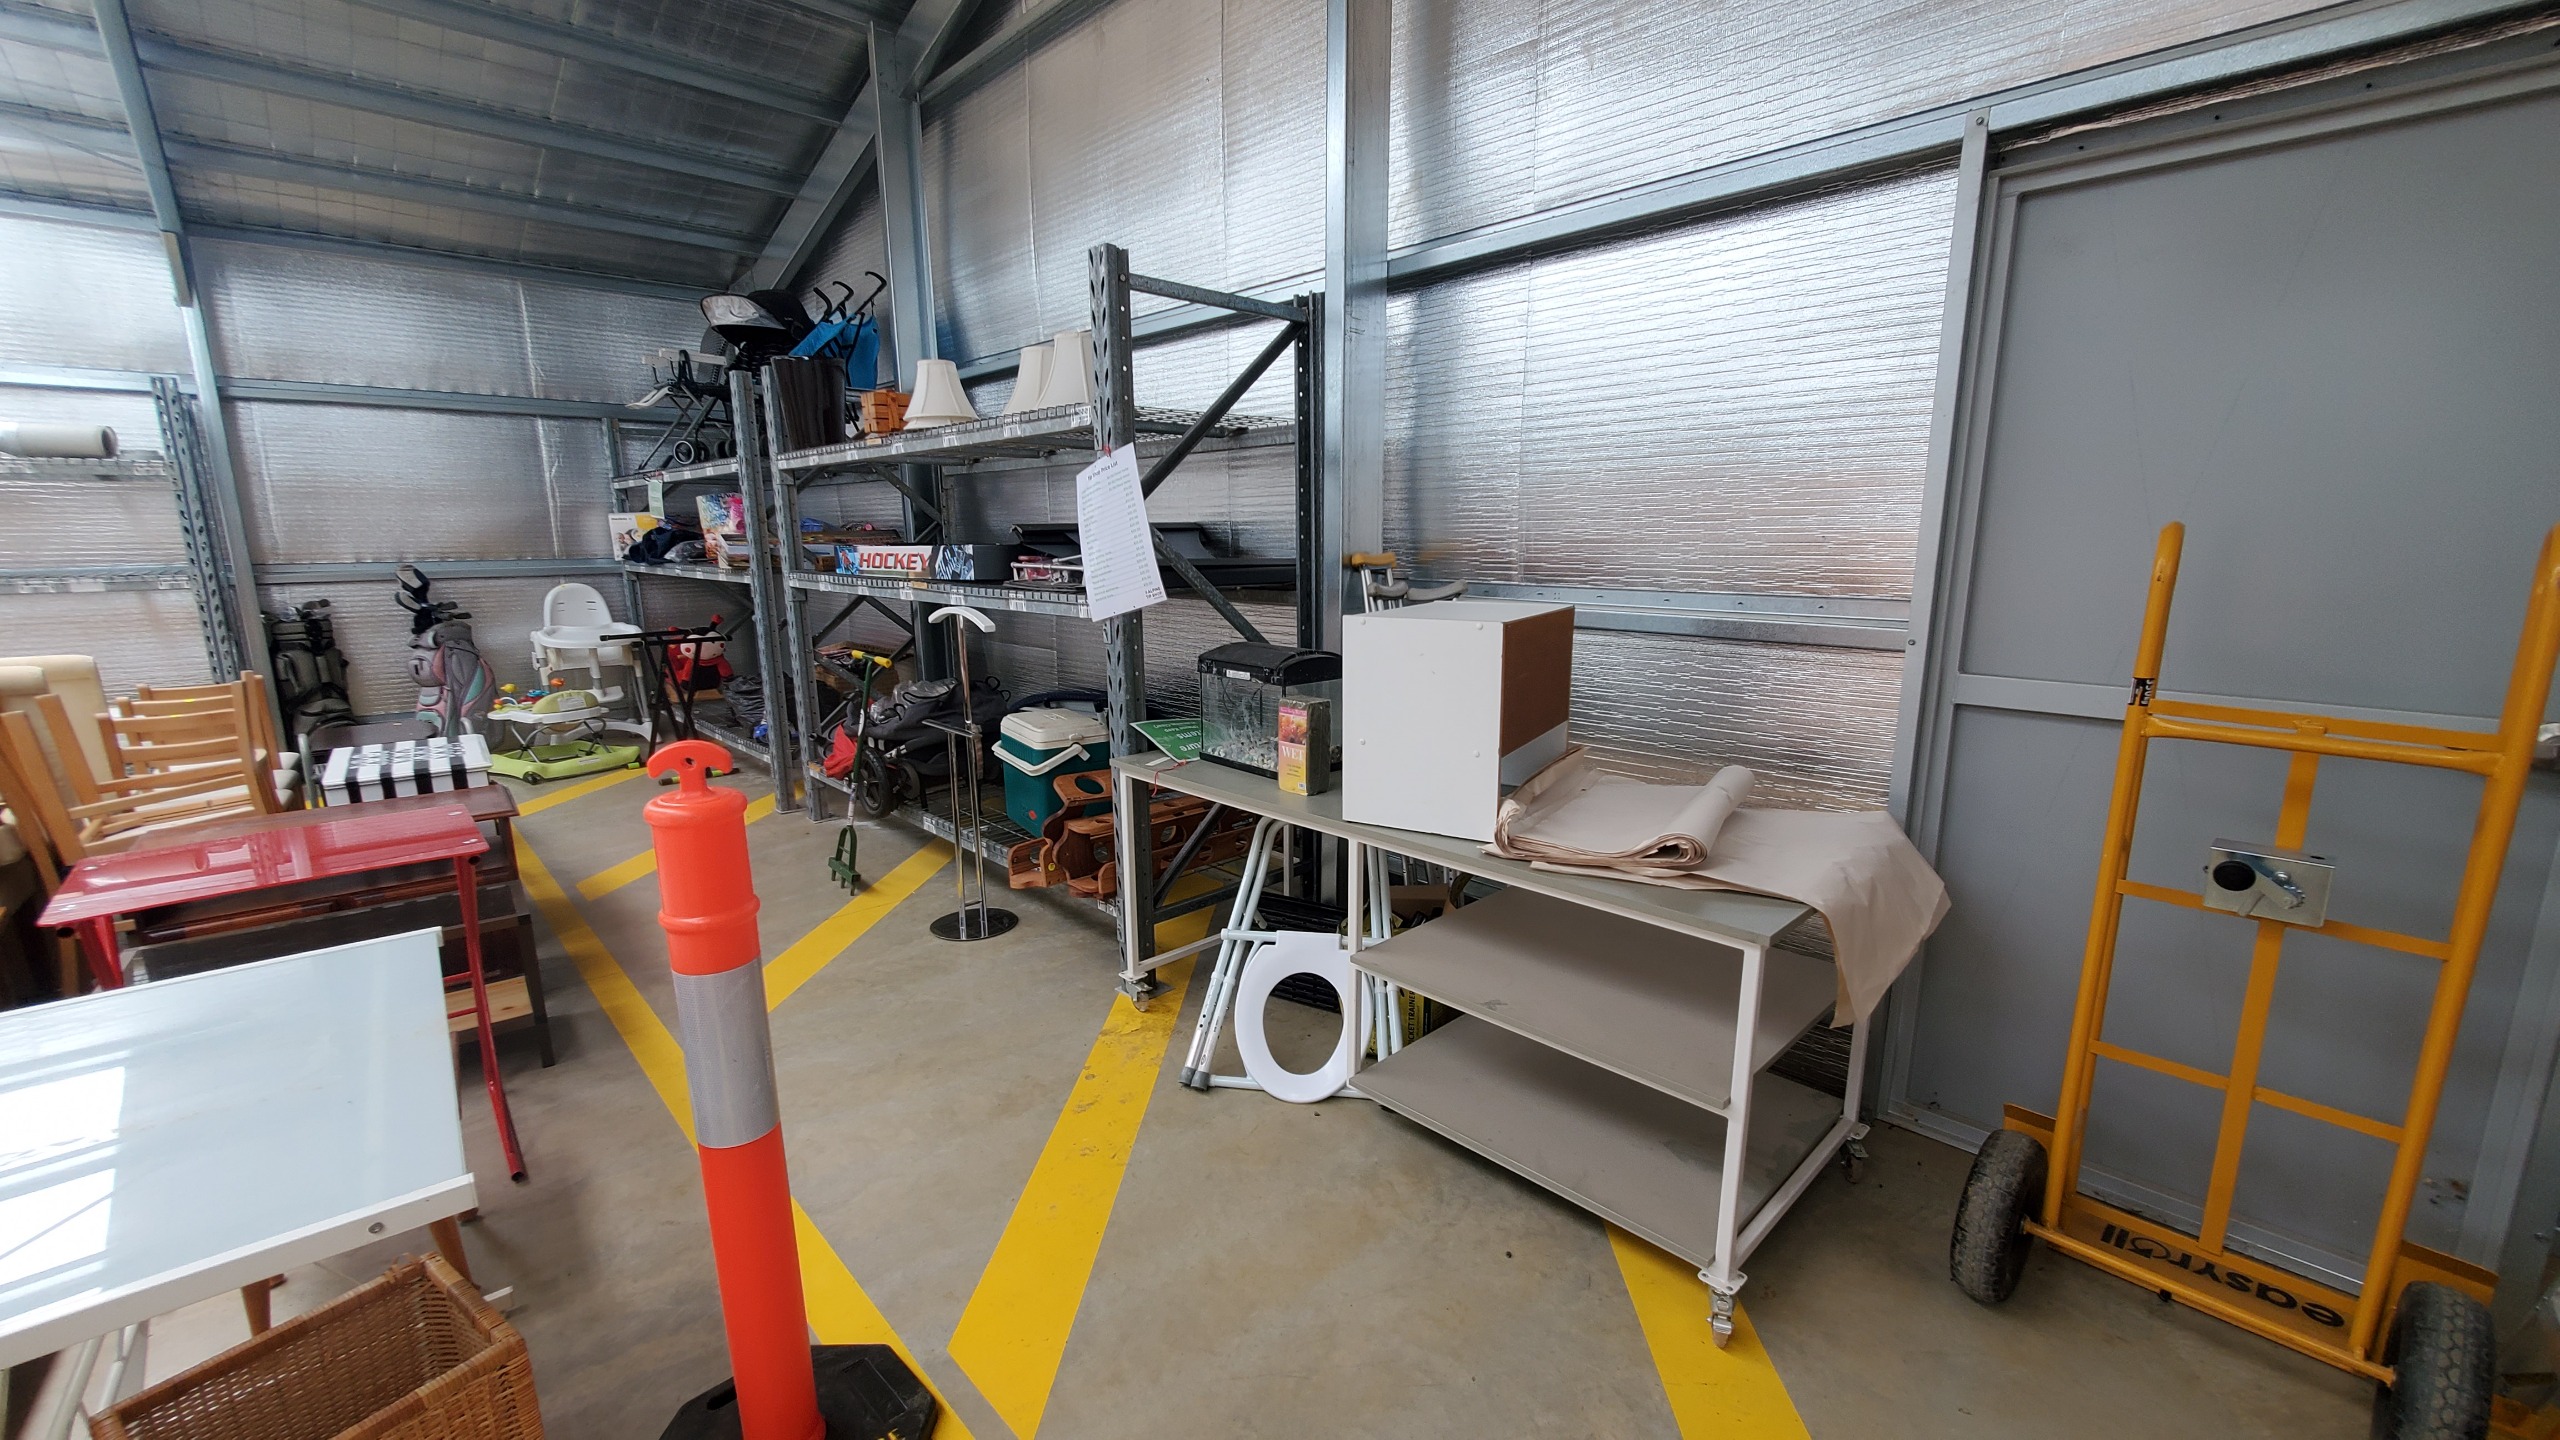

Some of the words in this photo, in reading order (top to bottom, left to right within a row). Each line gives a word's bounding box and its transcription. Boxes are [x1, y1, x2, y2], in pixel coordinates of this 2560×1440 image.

[1100, 465, 1110, 473] Price
[859, 551, 930, 571] HOCKEY
[1176, 730, 1201, 740] tems
[1179, 742, 1201, 752] ture
[1282, 745, 1305, 760] WET
[2100, 1224, 2344, 1328] easyroll
